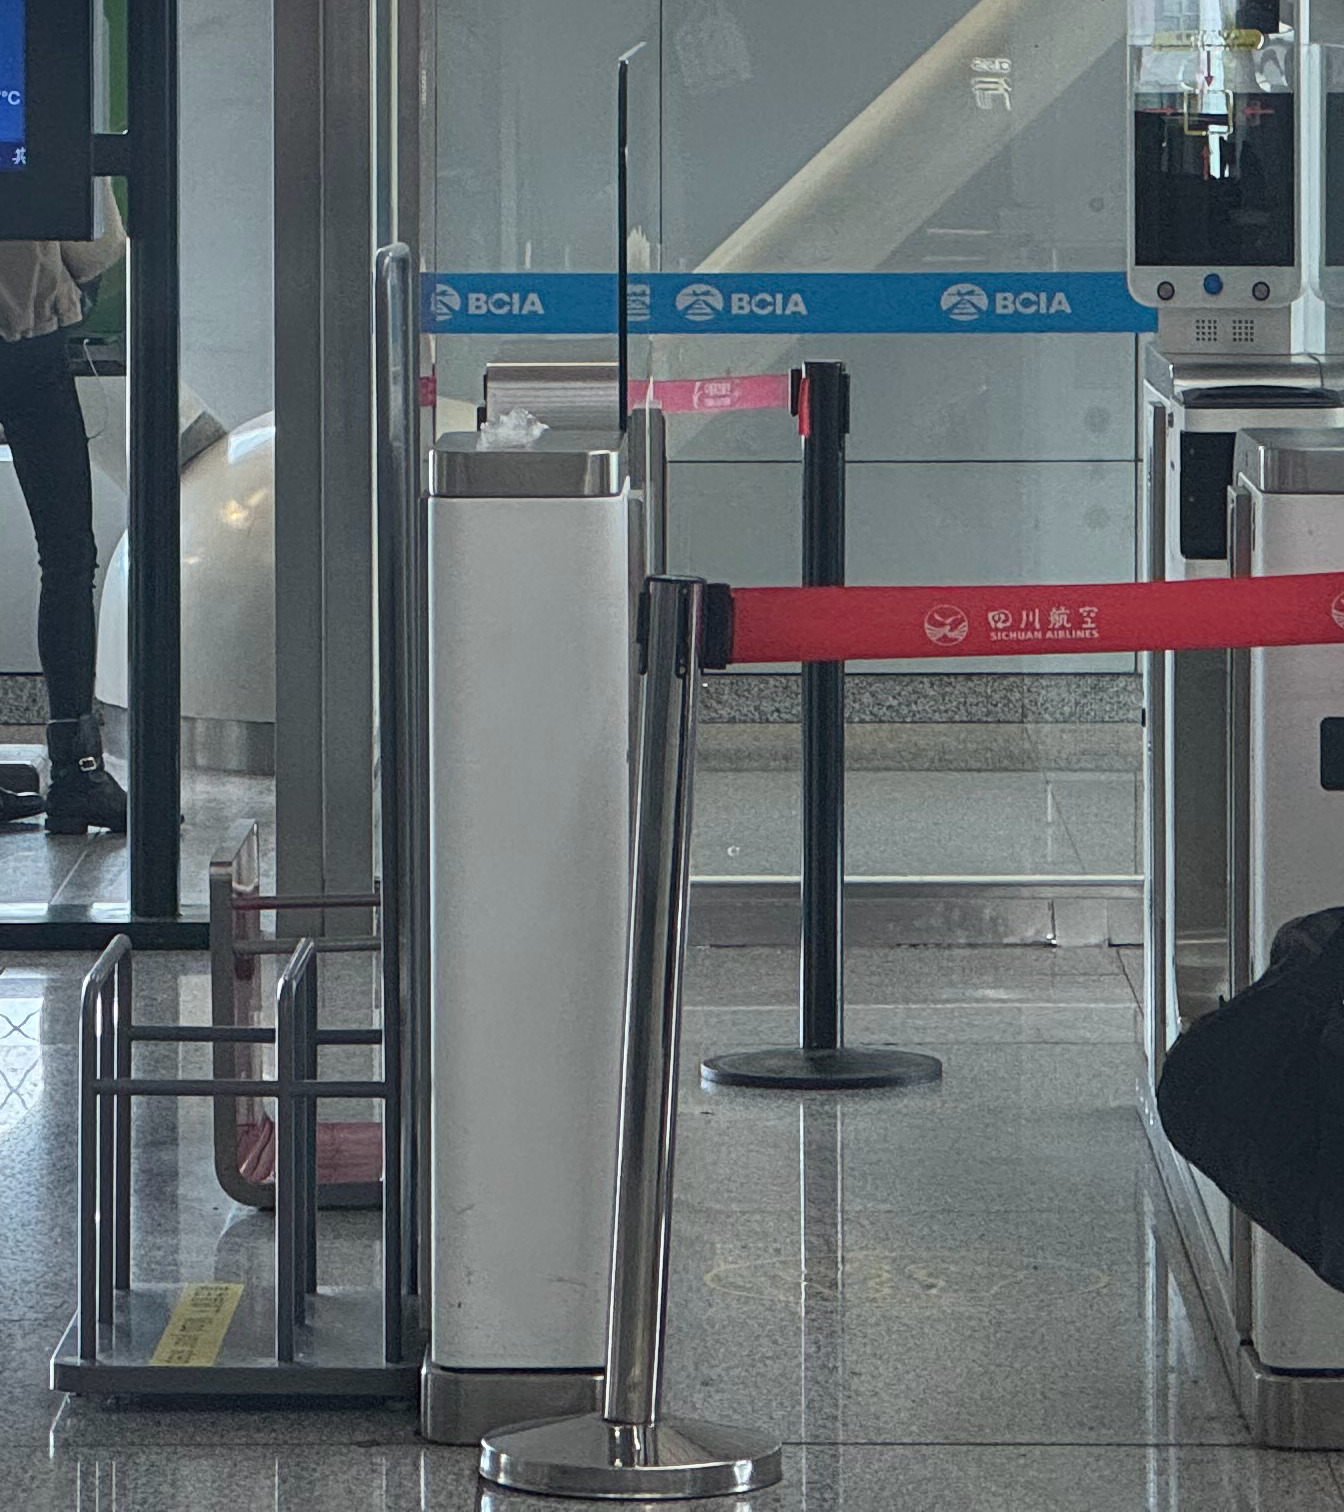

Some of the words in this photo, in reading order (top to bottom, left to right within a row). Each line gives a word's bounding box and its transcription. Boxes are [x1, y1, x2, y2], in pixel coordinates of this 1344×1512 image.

[468, 293, 545, 315] BCIA
[731, 292, 808, 315] BCIA
[995, 292, 1072, 314] BCIA
[988, 606, 1099, 630] 四川航空
[990, 630, 1042, 641] SICHUAN
[1046, 628, 1099, 640] AIRLINES
